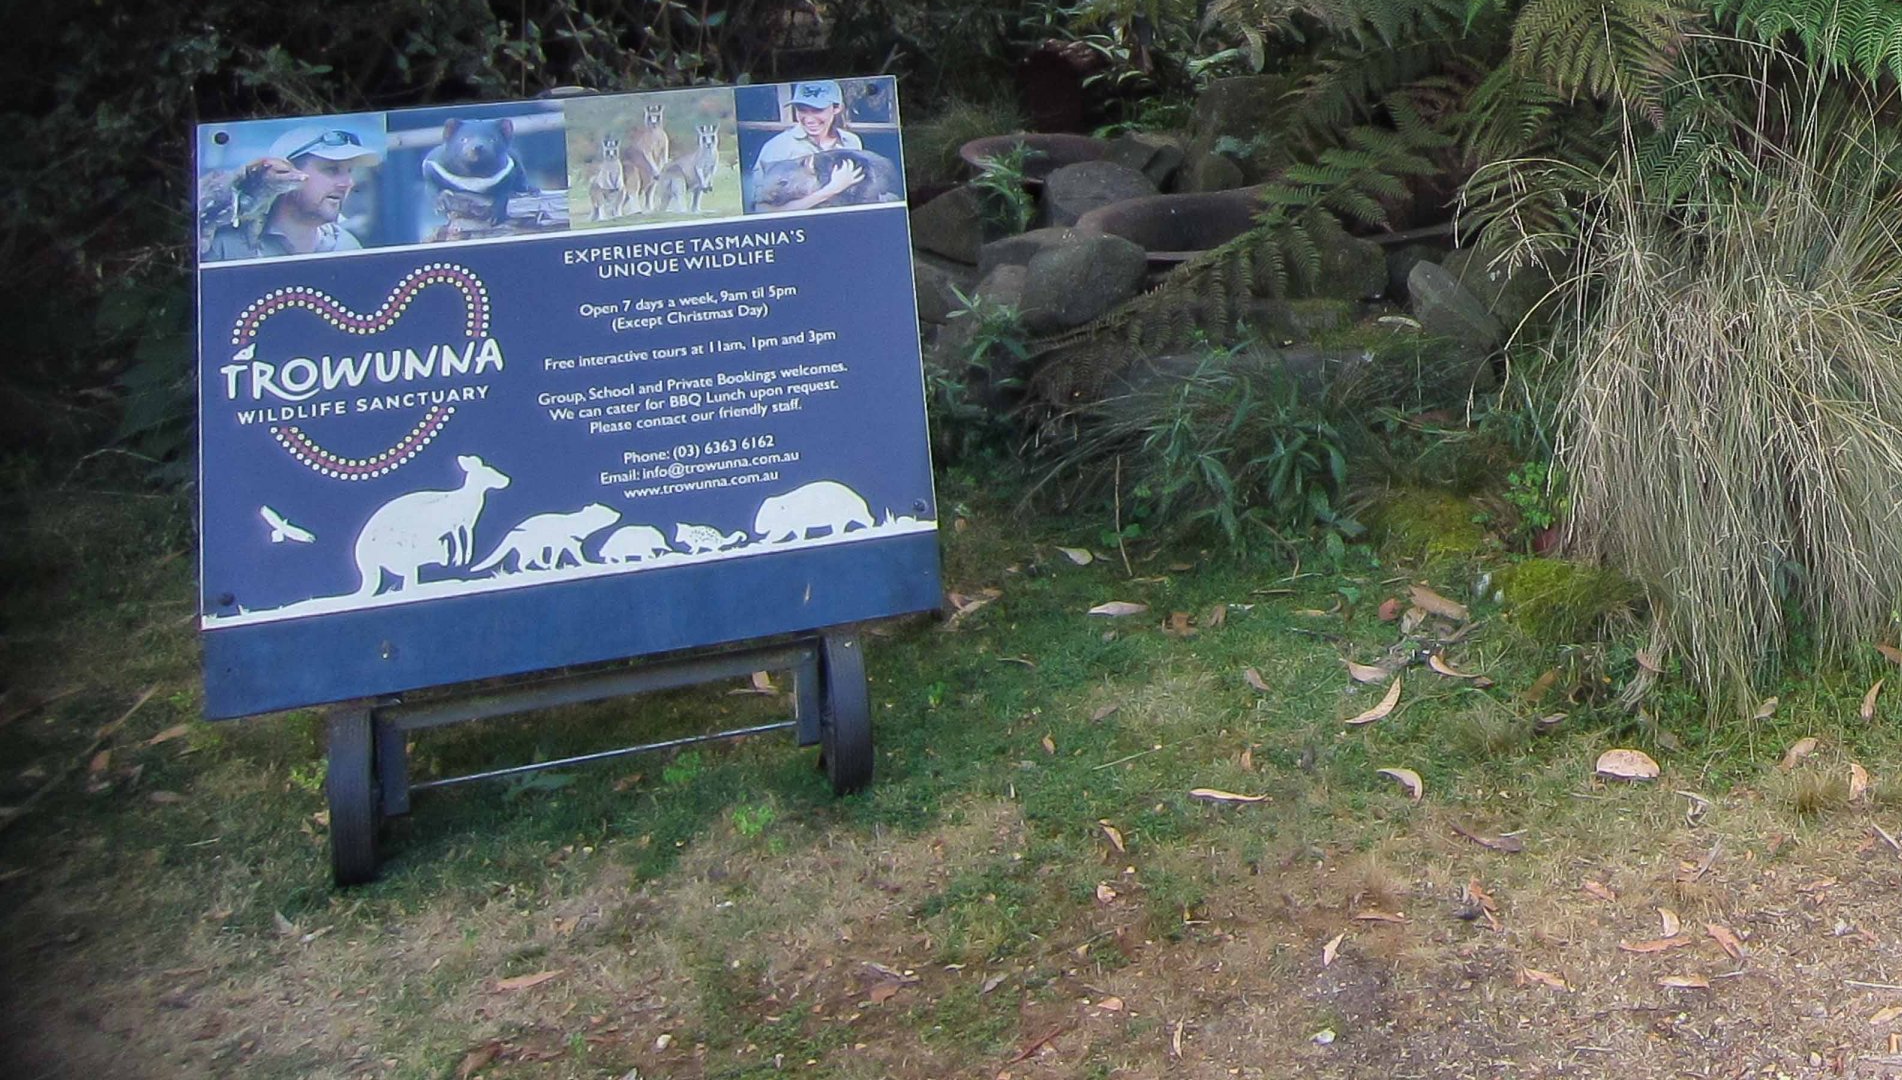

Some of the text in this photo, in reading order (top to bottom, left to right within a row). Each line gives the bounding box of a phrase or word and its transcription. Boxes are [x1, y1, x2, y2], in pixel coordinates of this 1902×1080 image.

[564, 229, 806, 264] EXPERIENCE TASMANIA'S
[598, 250, 775, 278] UNIQUE WILDLIFE
[579, 285, 797, 318] Open 7 days a week, 9am til 5pm
[612, 303, 768, 333] (Except Christmas Day)
[544, 330, 836, 370] Free interactive tours at 11am, 1pm and 3pm
[220, 338, 504, 400] TROWUNNA
[538, 361, 847, 407] Group, School and Private Bookings welcomes.
[237, 386, 490, 424] WILDLIFE SANCTUARY
[550, 380, 838, 420] We can cater for BBQ Lunch upon request.
[590, 399, 801, 434] Please contact our friendly staff.
[624, 435, 774, 464] Phone: (03) 6363 6162
[600, 451, 799, 484] Email: info@trowunna.com.au
[624, 472, 778, 499] www.trowunna.com.au
